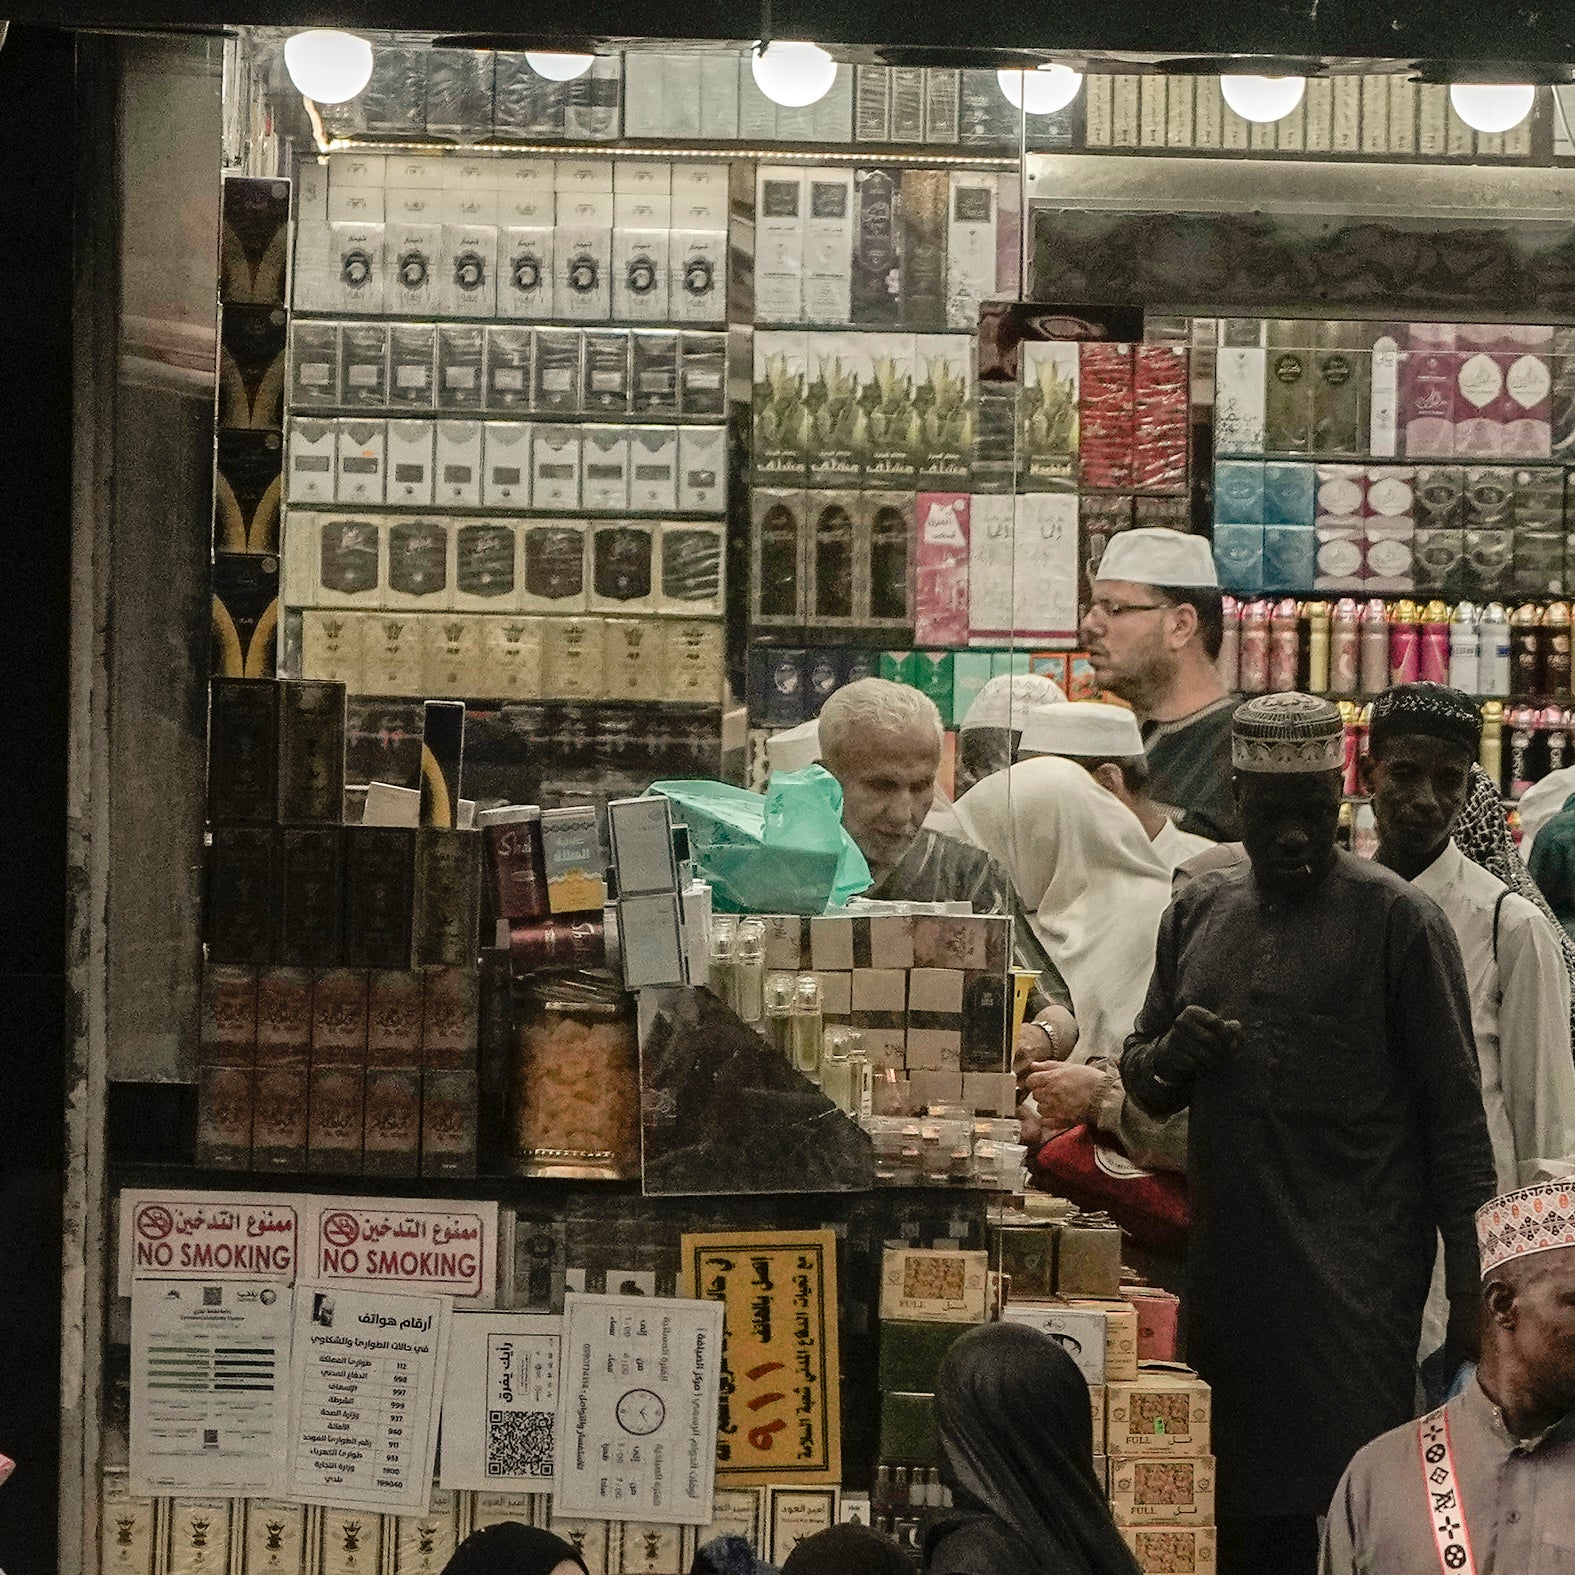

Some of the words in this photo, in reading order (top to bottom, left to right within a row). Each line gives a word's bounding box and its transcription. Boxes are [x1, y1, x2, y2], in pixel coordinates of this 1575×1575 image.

[176, 1210, 240, 1235] التدخين
[247, 1211, 292, 1237] ممنوع
[360, 1214, 426, 1242] التدخين
[432, 1216, 478, 1245] ممنوع
[138, 1242, 173, 1266] NO
[181, 1242, 291, 1270] SMOKING
[323, 1248, 359, 1273] NO
[366, 1250, 476, 1278] SMOKING
[358, 1313, 396, 1328] هواتف
[400, 1315, 432, 1332] أرقام
[496, 1342, 514, 1370] رأيك
[498, 1374, 513, 1402] يفرق
[1126, 1436, 1152, 1444] FULL
[1130, 1506, 1157, 1514] FULL
